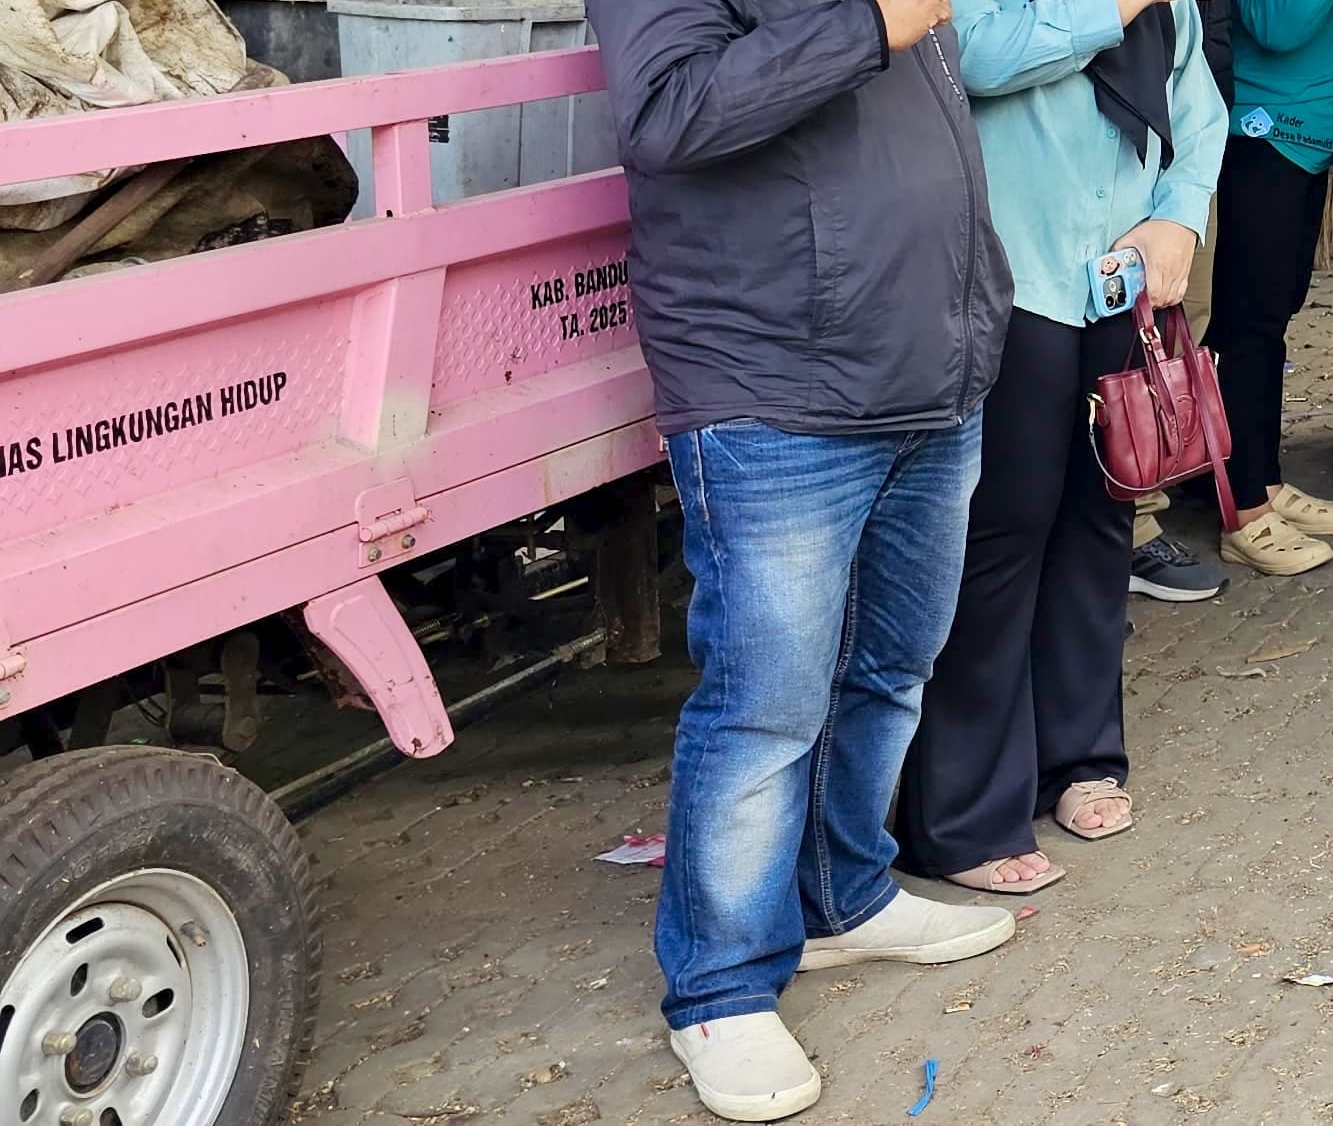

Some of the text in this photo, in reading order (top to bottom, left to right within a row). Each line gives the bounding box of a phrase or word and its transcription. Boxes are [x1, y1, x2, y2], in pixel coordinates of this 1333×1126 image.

[1276, 113, 1304, 128] Kader
[530, 260, 629, 310] KAB. BANDU
[560, 300, 627, 341] TA. 2025
[52, 392, 214, 464] LINGKUNGAN
[220, 371, 287, 417] HIDUP
